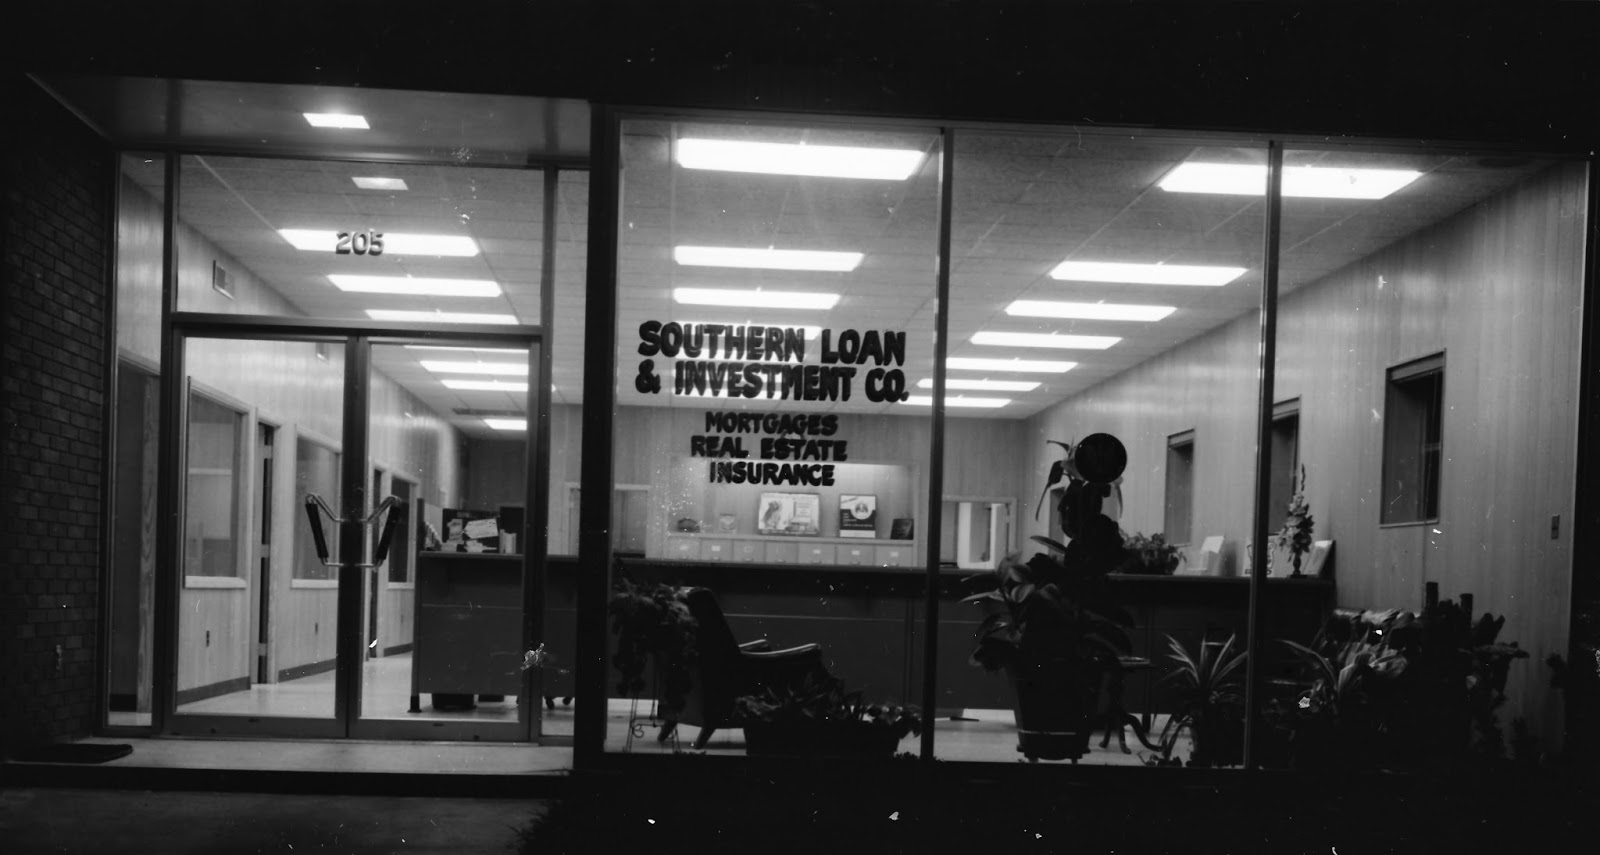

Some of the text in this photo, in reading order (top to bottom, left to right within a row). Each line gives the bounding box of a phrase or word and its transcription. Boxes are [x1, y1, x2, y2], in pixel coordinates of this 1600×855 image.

[336, 231, 384, 256] 205
[637, 320, 906, 366] SOUTHERN LOAN
[635, 359, 909, 403] & INVESTMENT CO.
[705, 411, 839, 436] MORTGAGES
[690, 435, 848, 461] REAL ESTATE
[709, 461, 836, 487] INSURANCE
